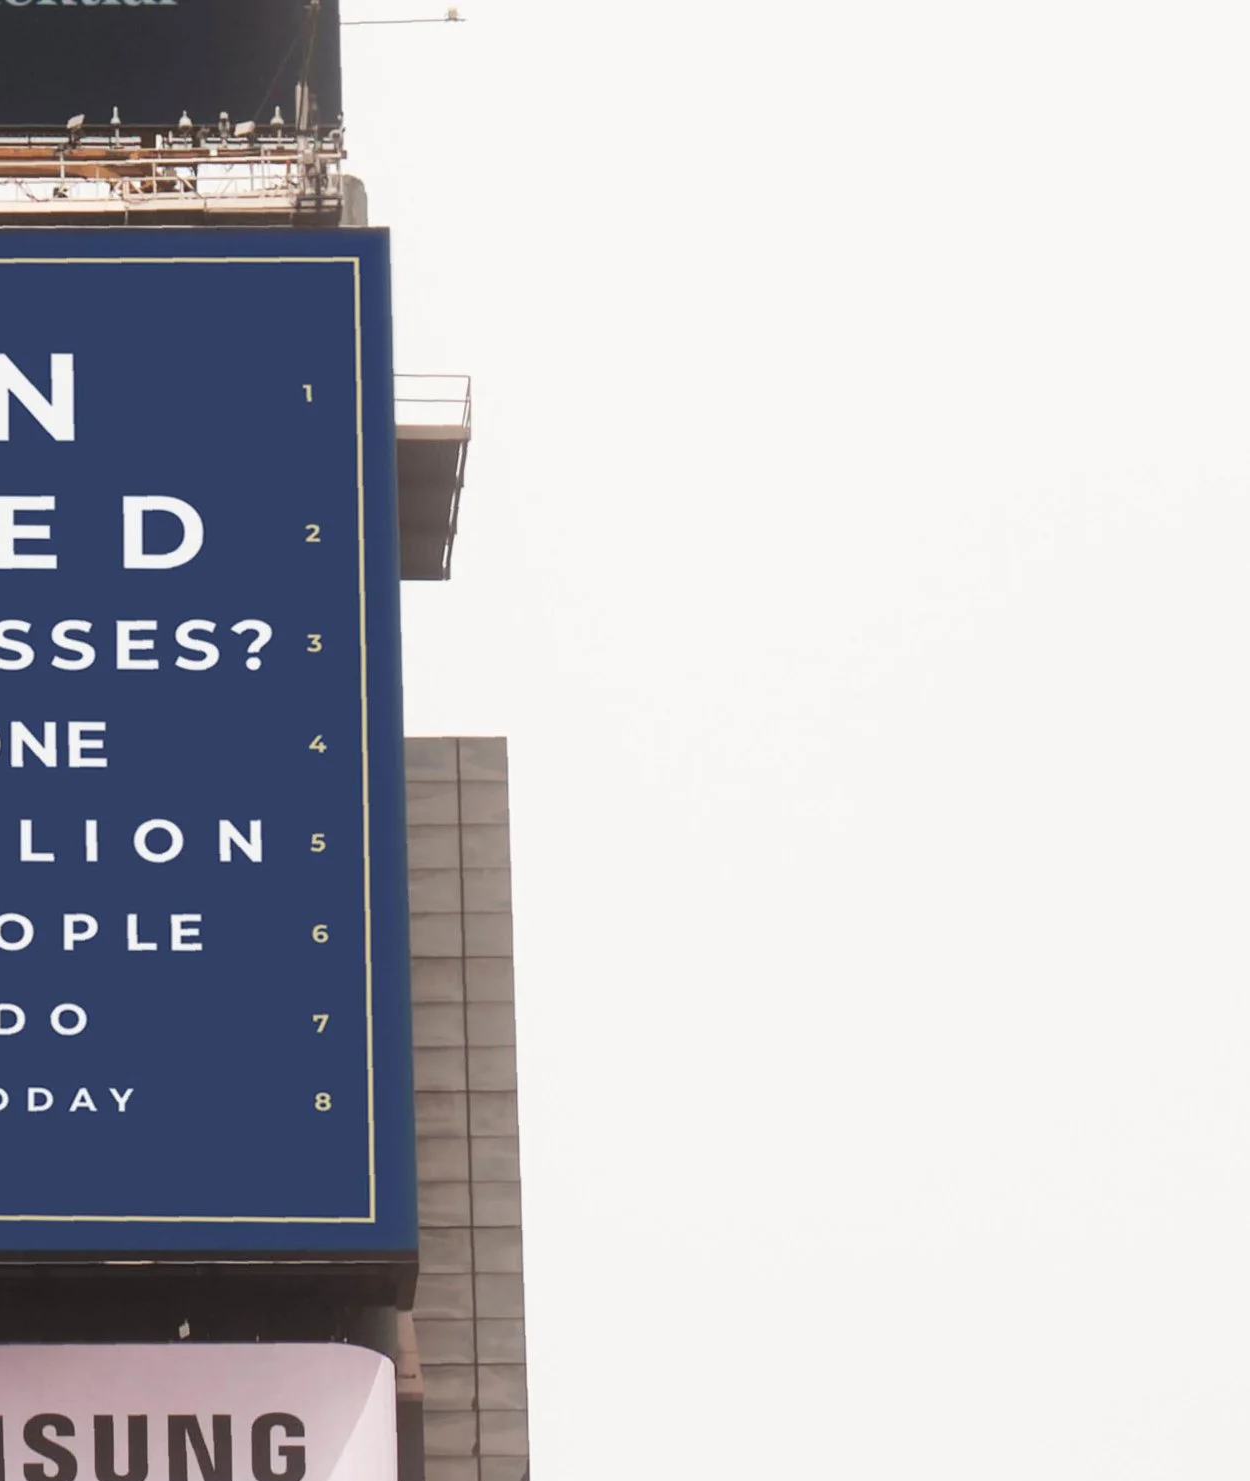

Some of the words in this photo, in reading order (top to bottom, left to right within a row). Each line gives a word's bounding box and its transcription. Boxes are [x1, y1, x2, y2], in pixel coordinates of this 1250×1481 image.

[302, 384, 313, 403] 1
[305, 523, 321, 543] 2
[306, 633, 323, 653] 3
[308, 734, 327, 753] 4
[310, 833, 326, 853] 5
[312, 924, 329, 943] 6
[312, 1014, 329, 1033] 7
[314, 1092, 332, 1112] 8
